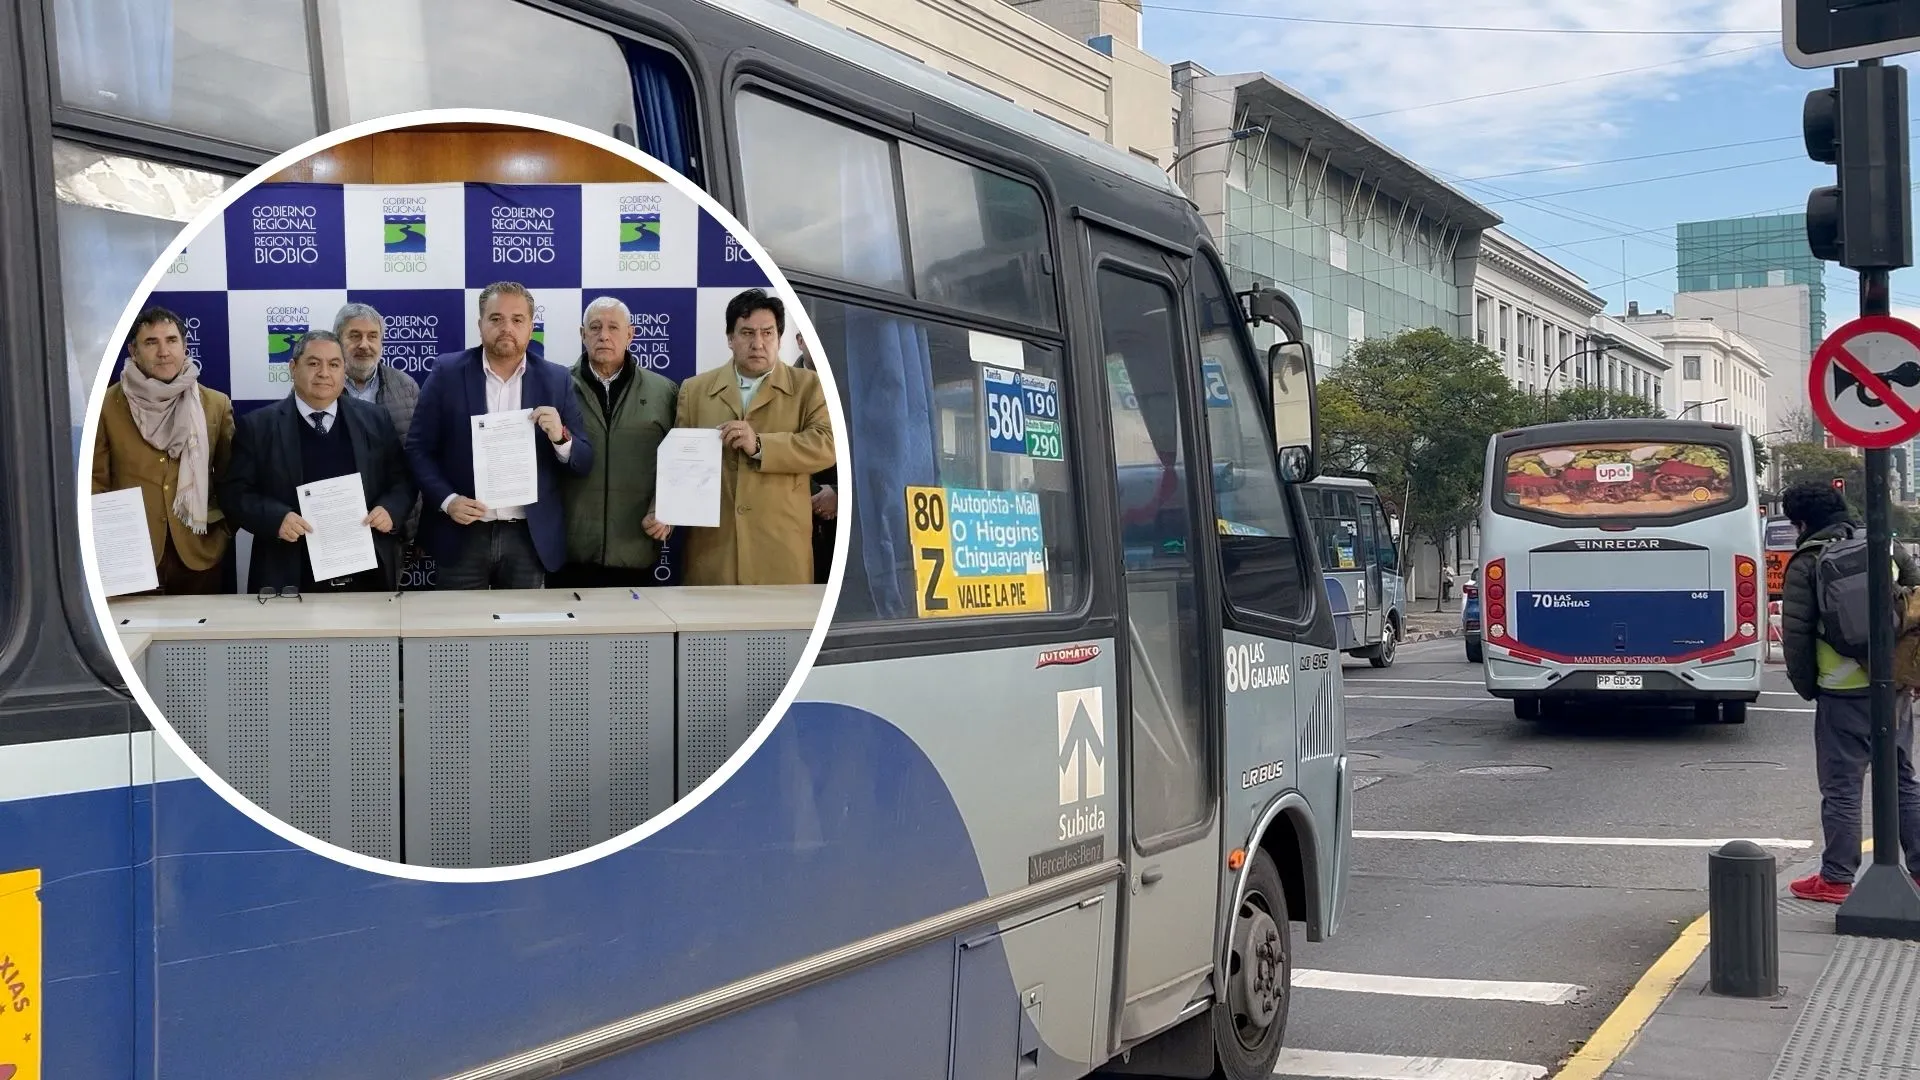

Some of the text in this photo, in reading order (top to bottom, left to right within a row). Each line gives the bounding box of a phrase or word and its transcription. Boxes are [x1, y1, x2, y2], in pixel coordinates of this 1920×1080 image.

[382, 197, 427, 206] GOBIERNO
[619, 195, 661, 204] GOBIERNO
[252, 205, 317, 218] GOBIERNO
[383, 205, 427, 214] REGIONAL
[491, 206, 555, 219] GOBIERNO
[619, 203, 661, 213] REGIONAL
[253, 218, 317, 230] REGIONAL
[491, 218, 555, 231] REGIONAL
[254, 236, 318, 247] REGION DEL
[492, 236, 555, 247] REGION DEL
[254, 247, 319, 264] BIOBIO
[492, 247, 556, 263] BIOBIO
[384, 261, 427, 273] BIOBIO
[619, 260, 661, 272] BIOBIO
[266, 306, 310, 315] GOBIERNO
[266, 314, 310, 323] REGIONAL
[384, 315, 439, 327] OBIERNO
[629, 313, 670, 325] BIERNO
[383, 327, 438, 339] EGIONAL
[382, 345, 439, 356] EGION DEL
[652, 342, 670, 353] DEL
[1026, 391, 1056, 417] 190
[988, 393, 1024, 442] 580
[1030, 433, 1059, 457] 290
[912, 491, 945, 533] 80
[1586, 539, 1660, 549] INRECAR
[920, 547, 949, 611] Z
[957, 582, 1026, 610] VALLE LA PIE
[1532, 594, 1552, 608] 70
[1691, 592, 1709, 600] 046
[1553, 600, 1590, 608] BAHIAS
[1249, 642, 1265, 664] LAS
[1312, 653, 1329, 670] 915
[1574, 656, 1667, 664] MANTENGA DISTANCIA
[1226, 644, 1250, 693] 80
[1250, 664, 1290, 689] GALAXIAS
[1059, 803, 1105, 841] Subida
